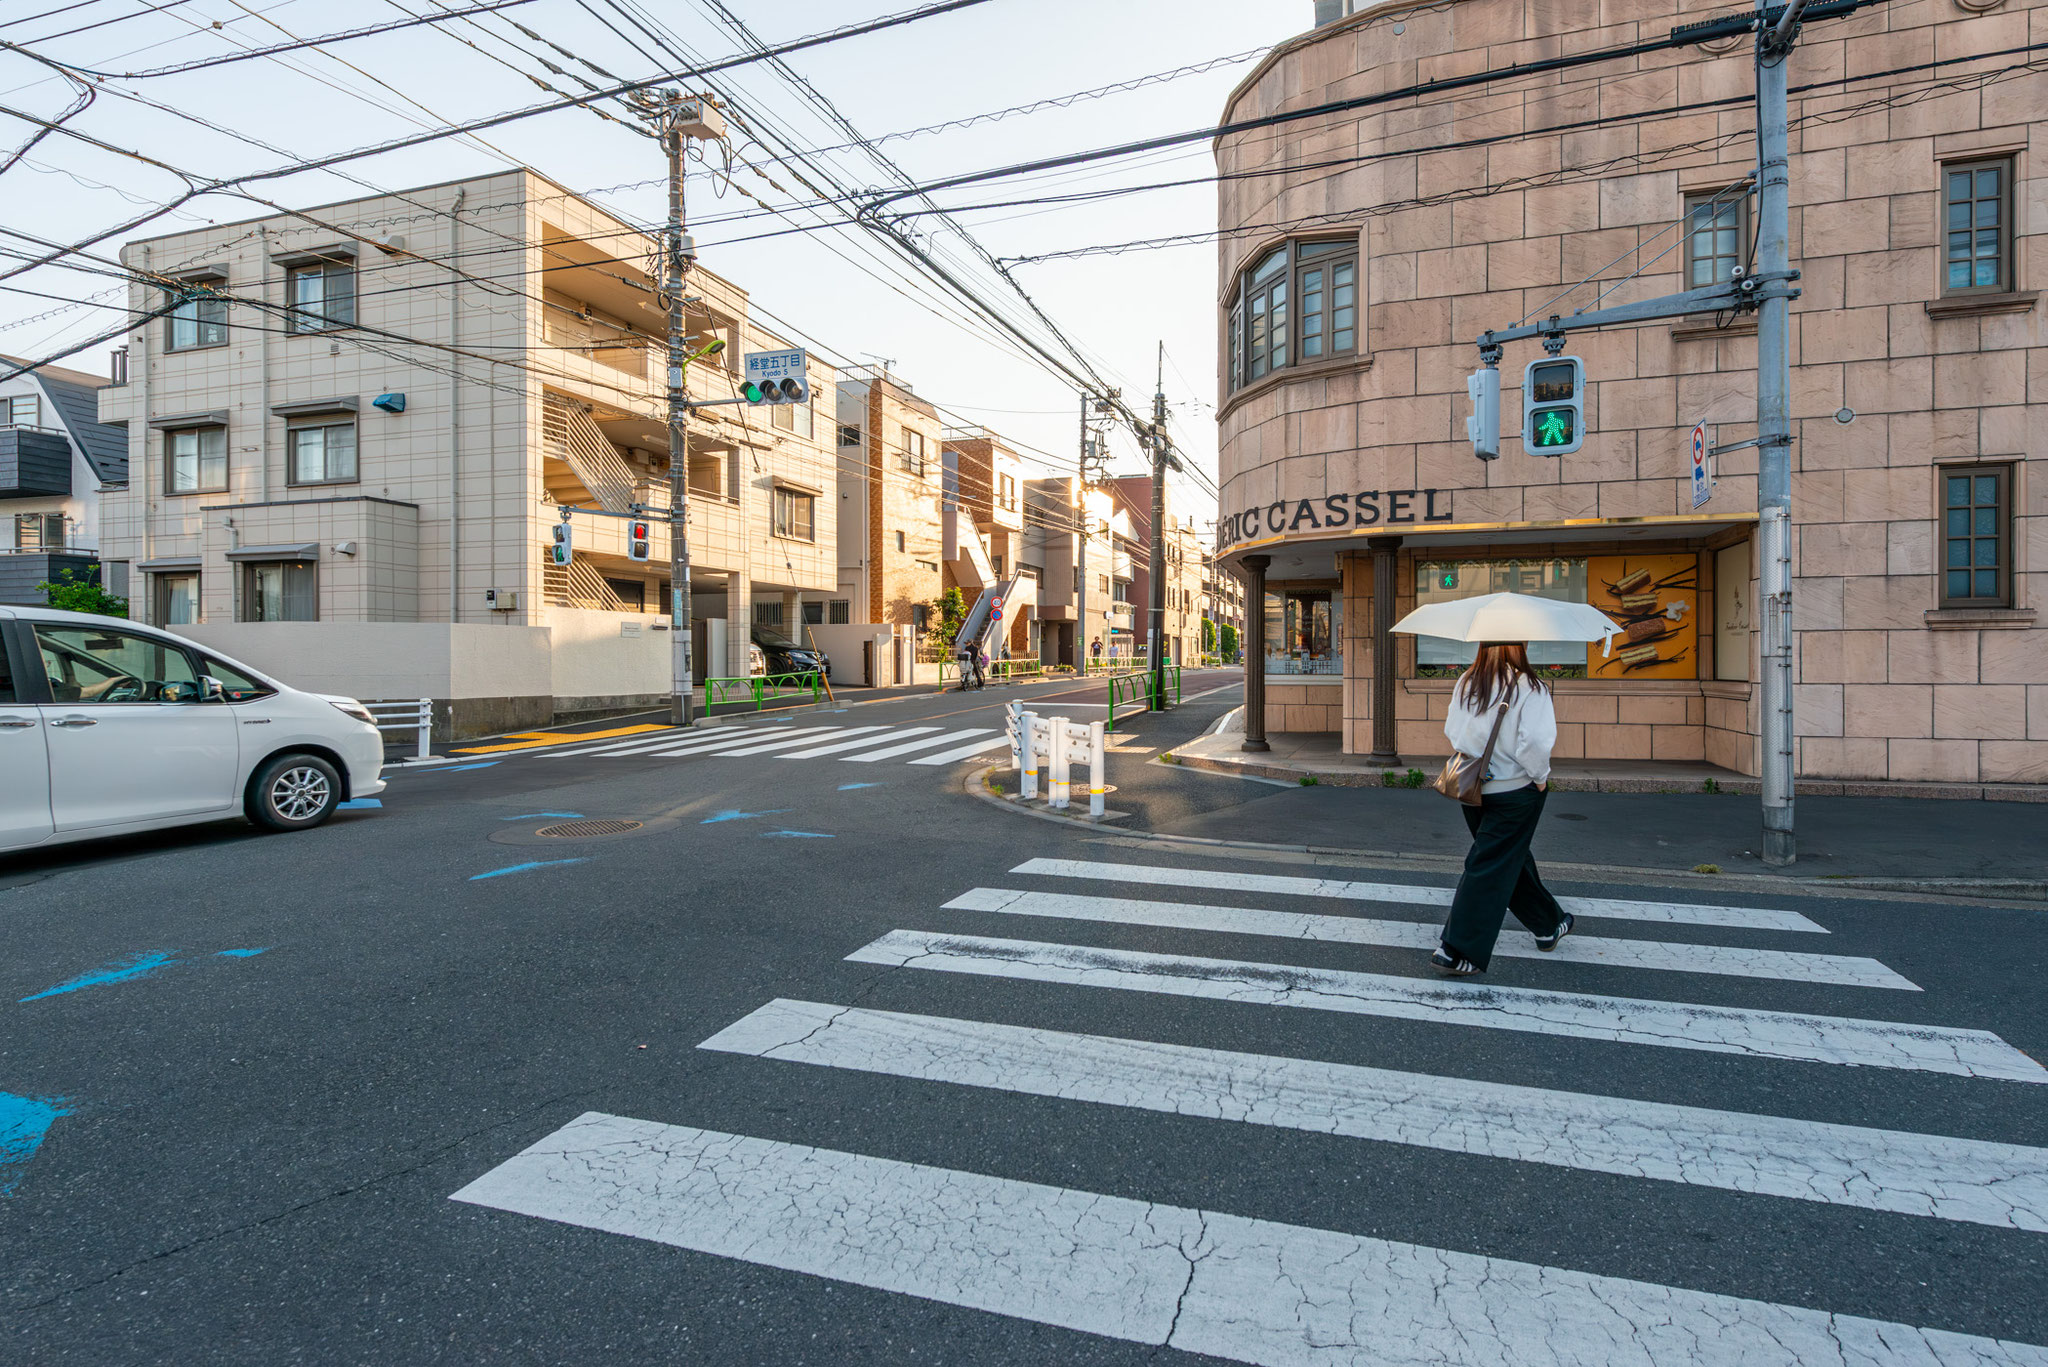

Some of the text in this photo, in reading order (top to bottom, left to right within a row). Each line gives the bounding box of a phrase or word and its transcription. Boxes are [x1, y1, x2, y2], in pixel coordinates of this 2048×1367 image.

[750, 354, 800, 370] 経堂五丁目
[762, 370, 781, 378] Kyodo
[1267, 489, 1453, 533] CASSEL
